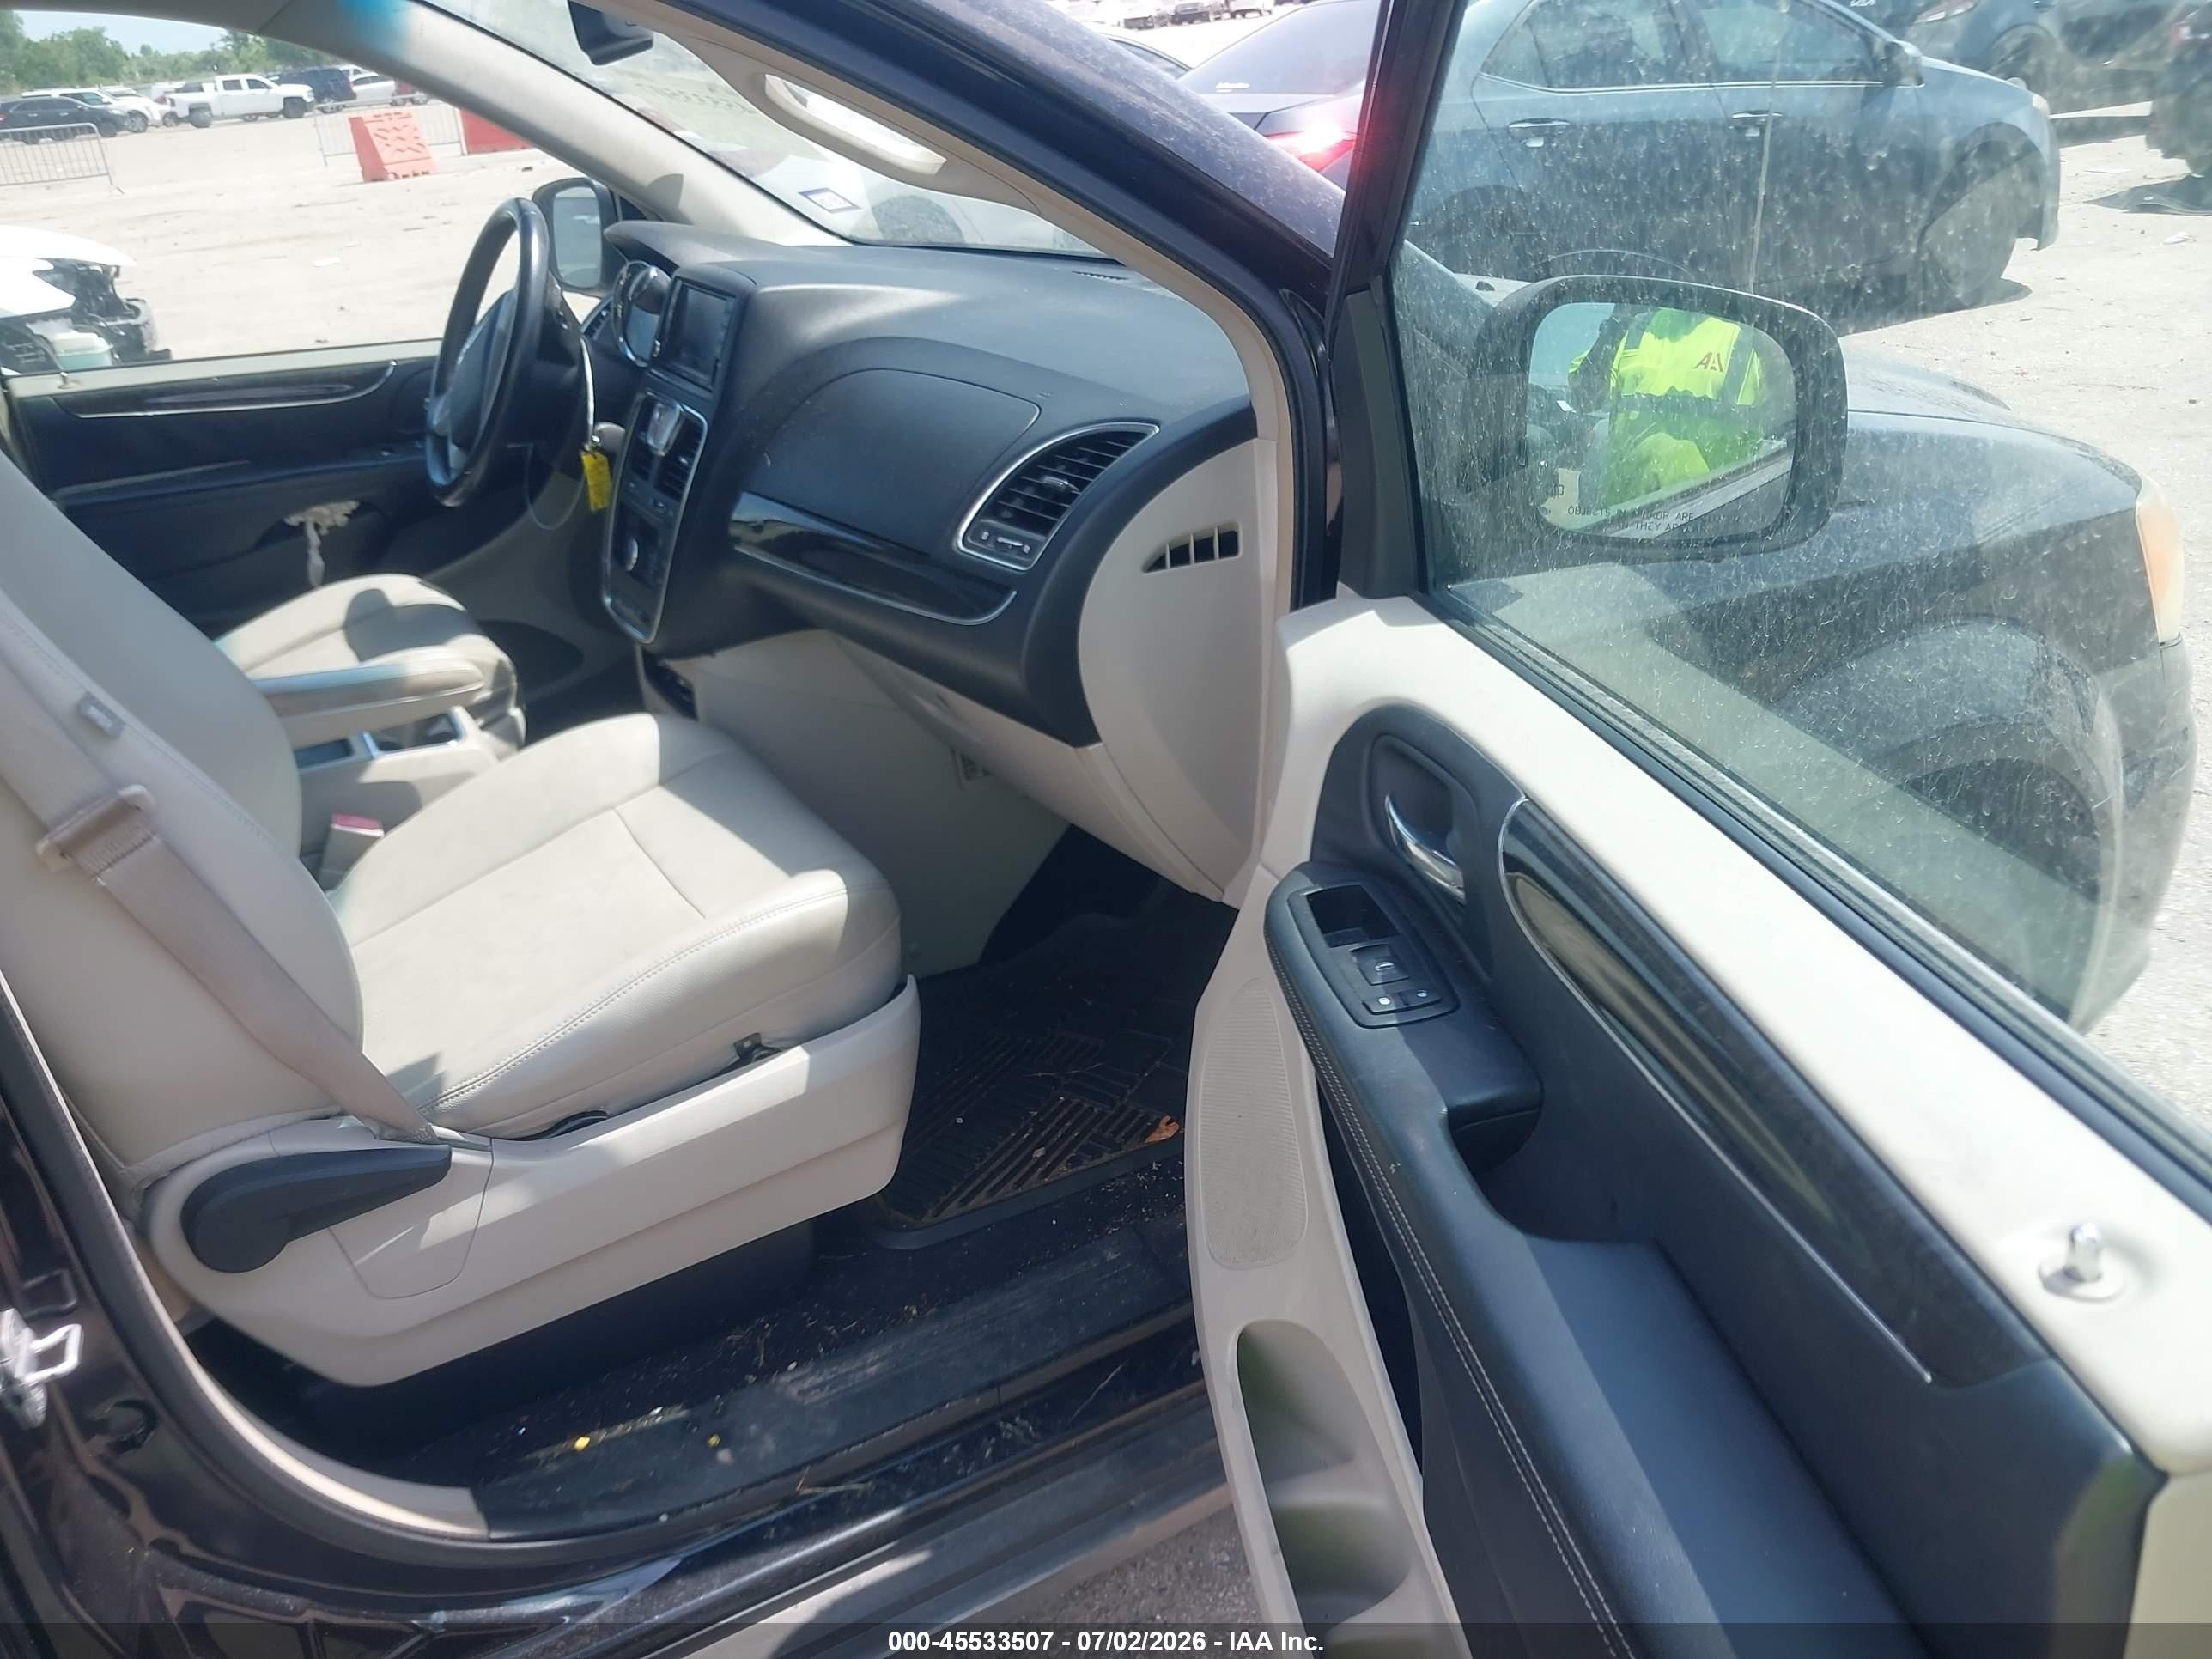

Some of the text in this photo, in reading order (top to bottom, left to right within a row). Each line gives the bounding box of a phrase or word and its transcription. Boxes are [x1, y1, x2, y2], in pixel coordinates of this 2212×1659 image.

[1567, 506, 1611, 517] OBJECTS
[1616, 507, 1626, 516] IN
[1635, 521, 1661, 532] THEY
